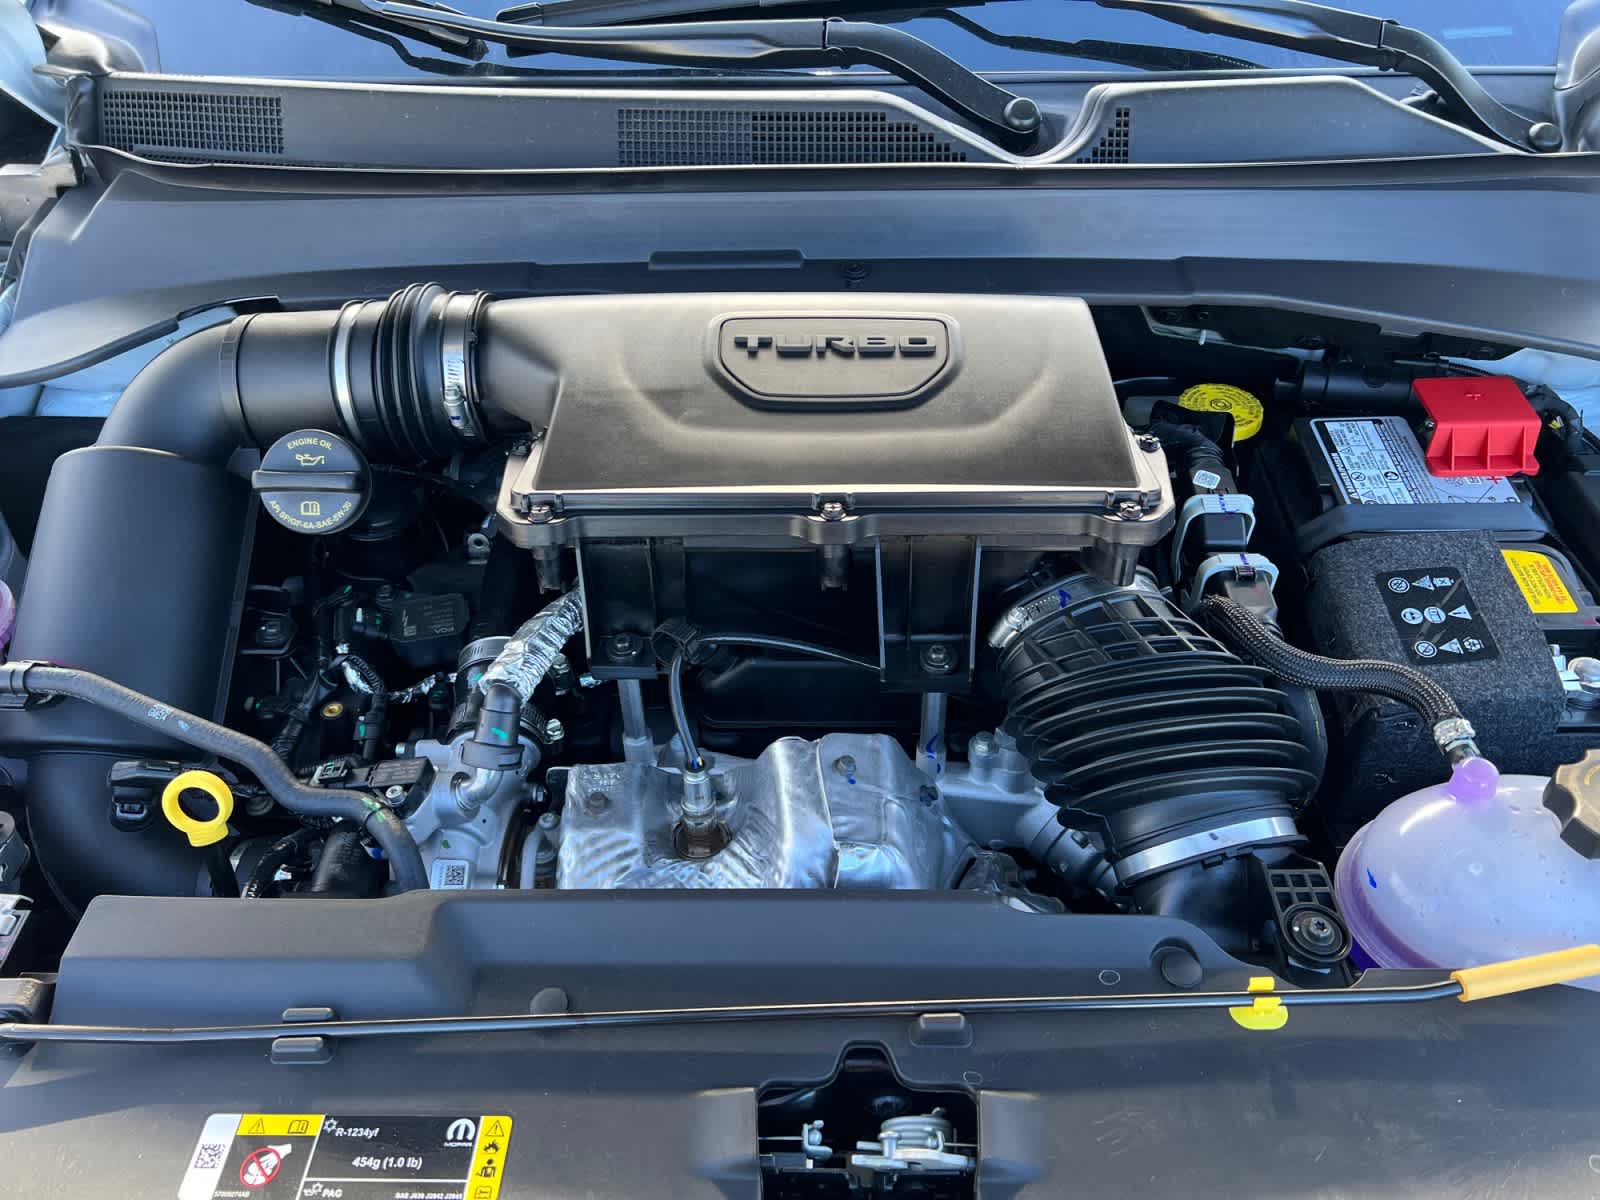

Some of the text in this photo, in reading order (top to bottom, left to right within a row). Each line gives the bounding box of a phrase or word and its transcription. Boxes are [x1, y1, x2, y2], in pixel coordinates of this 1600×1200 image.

[734, 336, 936, 358] TURBO
[287, 437, 332, 450] ENGINE OIL
[335, 1127, 380, 1139] R-1234yf
[351, 1156, 423, 1170] 454g (1.0 lb)
[321, 1188, 344, 1198] PAG
